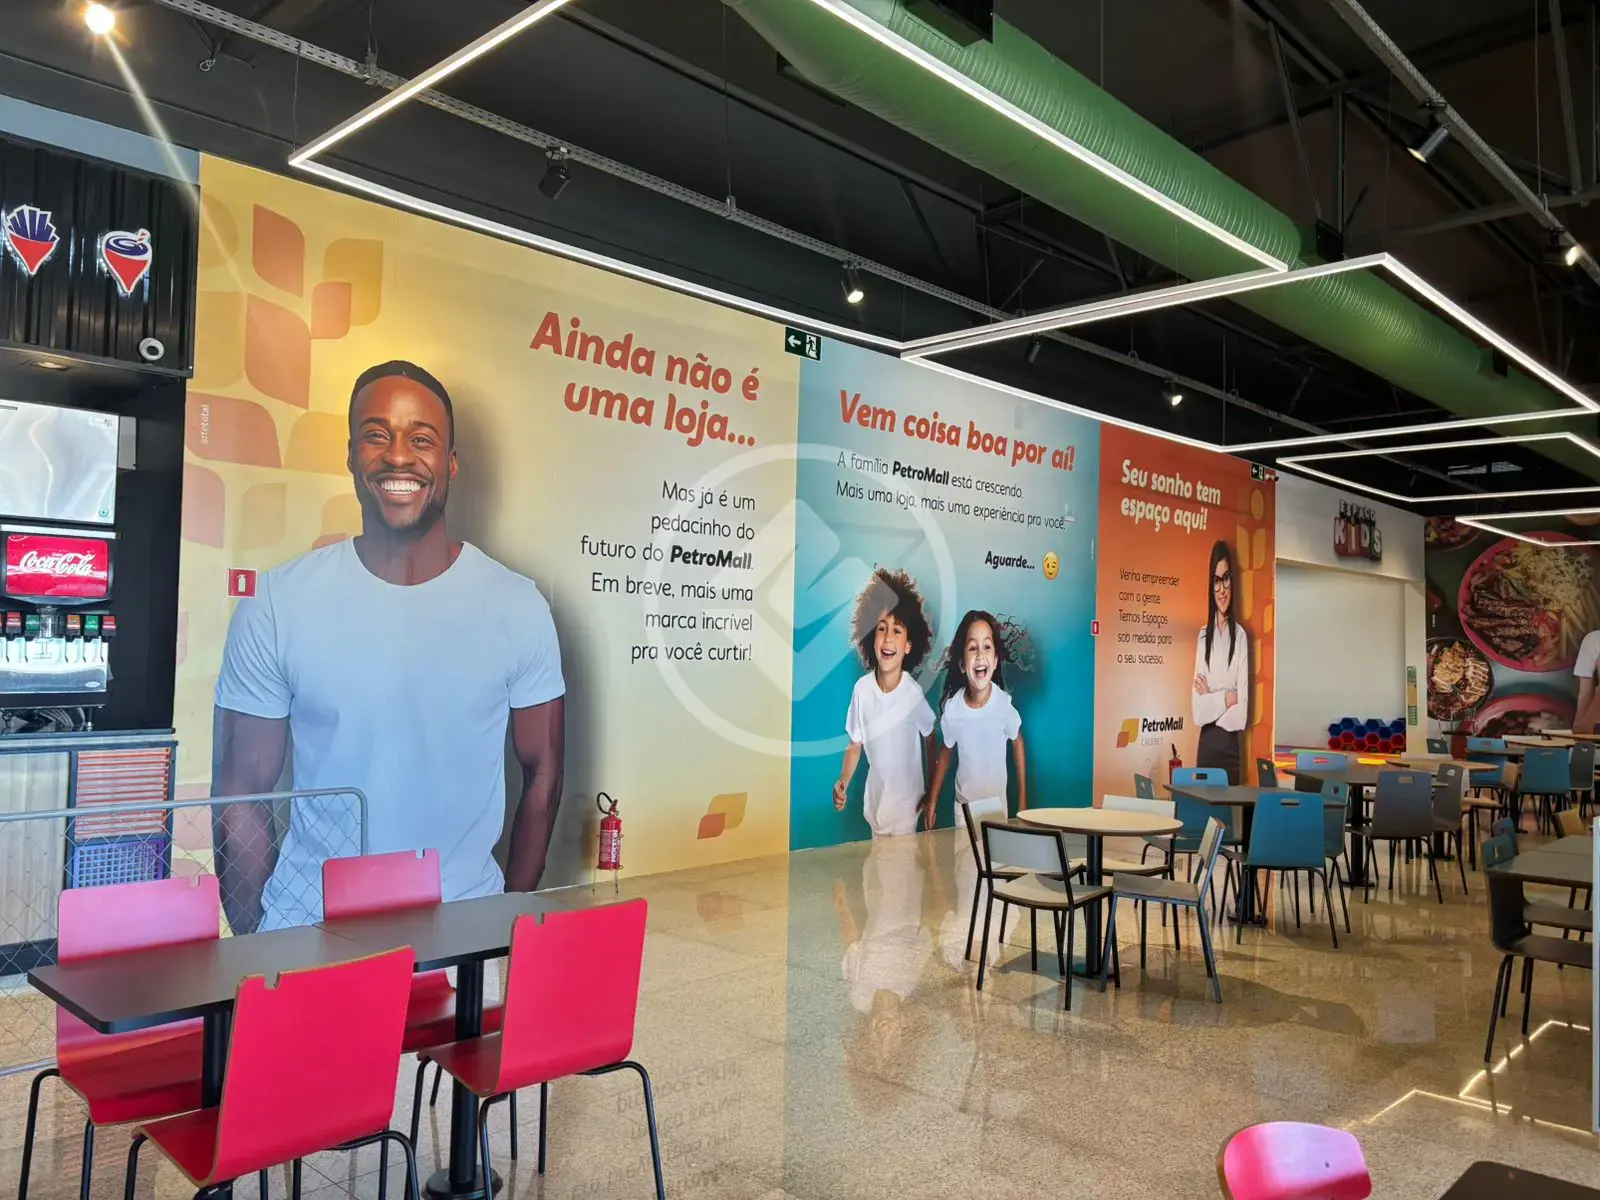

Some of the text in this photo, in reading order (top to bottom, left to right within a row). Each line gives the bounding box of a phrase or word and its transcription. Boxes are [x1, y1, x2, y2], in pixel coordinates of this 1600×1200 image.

[529, 311, 760, 401] Ainda não é
[564, 382, 756, 447] uma loja...
[840, 389, 1076, 472] Vem coisa boa por aí!
[837, 451, 1024, 499] A família PetroMall está crescendo.
[1121, 459, 1221, 505] Seu sonho tem
[662, 480, 756, 511] Mas já é um
[836, 480, 864, 499] Mais
[868, 489, 893, 503] uma
[896, 489, 918, 510] loja,
[920, 496, 945, 511] mais
[948, 502, 970, 515] uma
[973, 505, 1025, 524] experiência
[1027, 514, 1041, 529] pra
[651, 514, 755, 540] pedacinho do
[1121, 497, 1208, 534] espaço aqui!
[1334, 517, 1381, 555] KIDS
[581, 535, 753, 570] futuro do PetroMall.
[985, 550, 1035, 570] Aguarde...
[592, 571, 753, 601] Em breve, mais uma
[1119, 567, 1180, 587] Venha empreender
[1118, 591, 1134, 602] com
[1142, 592, 1160, 606] gente
[645, 611, 753, 631] marca incrível
[1118, 608, 1168, 629] Temos Espaços
[631, 642, 752, 664] pra você curtir!
[1117, 631, 1172, 647] sob medida para
[1117, 653, 1122, 664] o
[1125, 653, 1136, 664] seu
[1141, 717, 1184, 733] PetroMall
